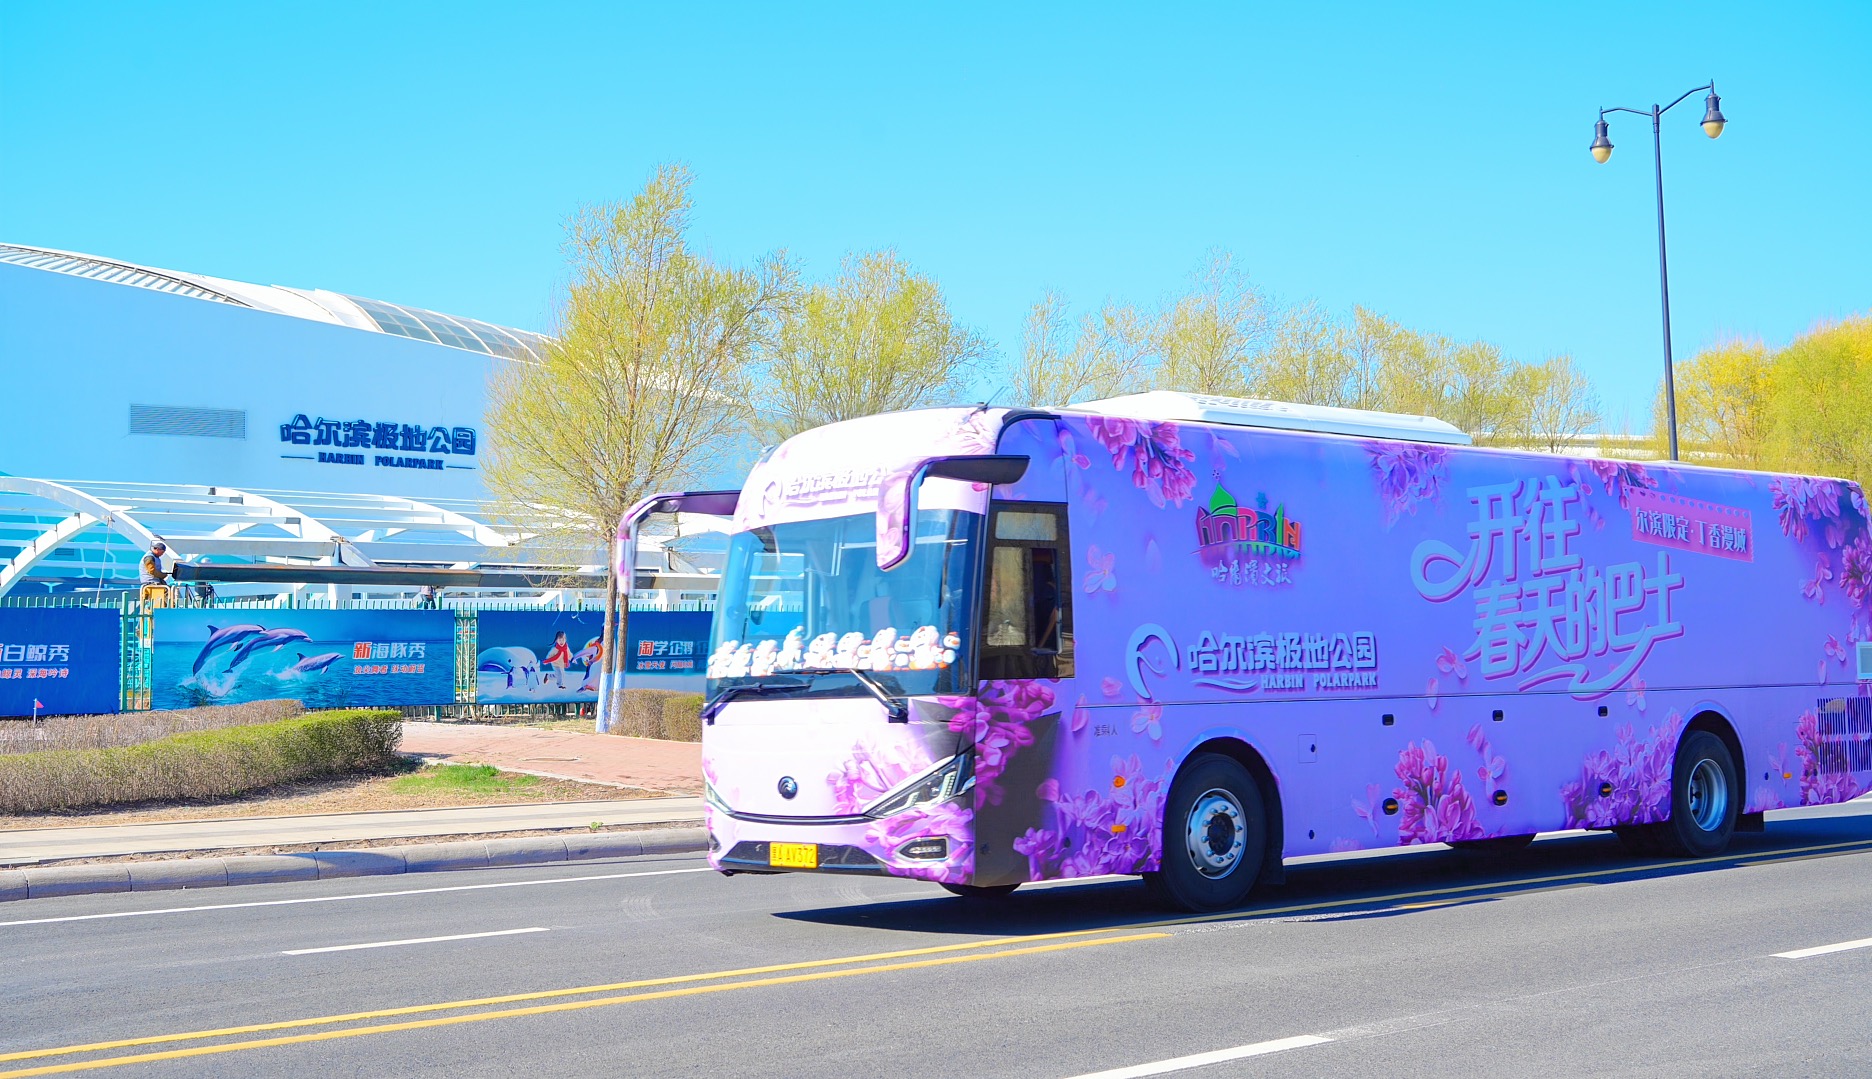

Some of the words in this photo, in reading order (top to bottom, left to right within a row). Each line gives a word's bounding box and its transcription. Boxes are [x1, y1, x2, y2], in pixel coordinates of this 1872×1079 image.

[279, 413, 476, 455] 哈尔滨极地公园
[318, 452, 364, 465] HARBIN
[374, 455, 444, 470] POLARPARK
[1412, 475, 1583, 598] 开往
[1463, 551, 1684, 694] 春天的巴士
[0, 644, 70, 662] 白鲸秀
[352, 641, 426, 660] 新海豚秀
[1187, 630, 1377, 672] 哈尔滨极地公园
[1261, 673, 1304, 689] HARBIN
[1313, 672, 1377, 689] POLARPARK
